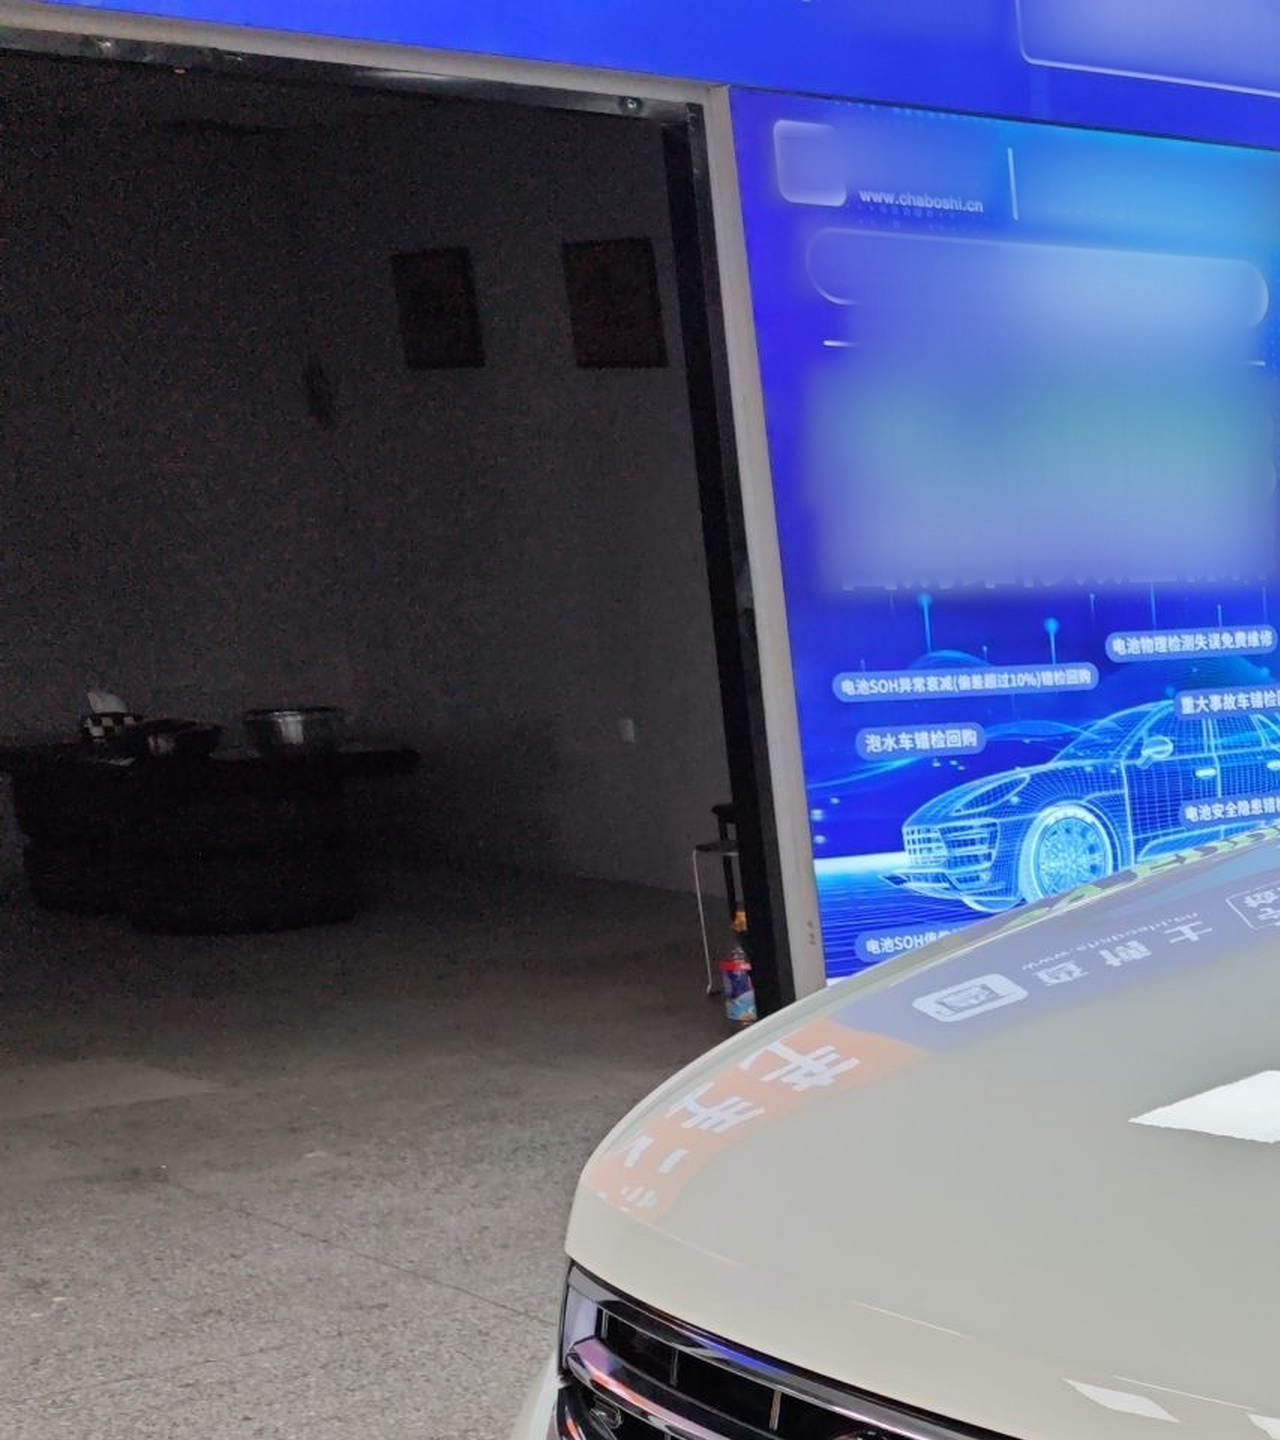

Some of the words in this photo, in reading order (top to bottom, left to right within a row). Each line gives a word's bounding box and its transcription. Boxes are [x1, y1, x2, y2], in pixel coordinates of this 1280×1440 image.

[858, 189, 984, 213] www.chaboshi.cn
[1111, 629, 1273, 656] 电池物理检测失误免费维修
[840, 668, 1092, 697] 电池SOH异常衰减(偏差超过10%)错检回购
[864, 728, 978, 754] 泡水车错检回购
